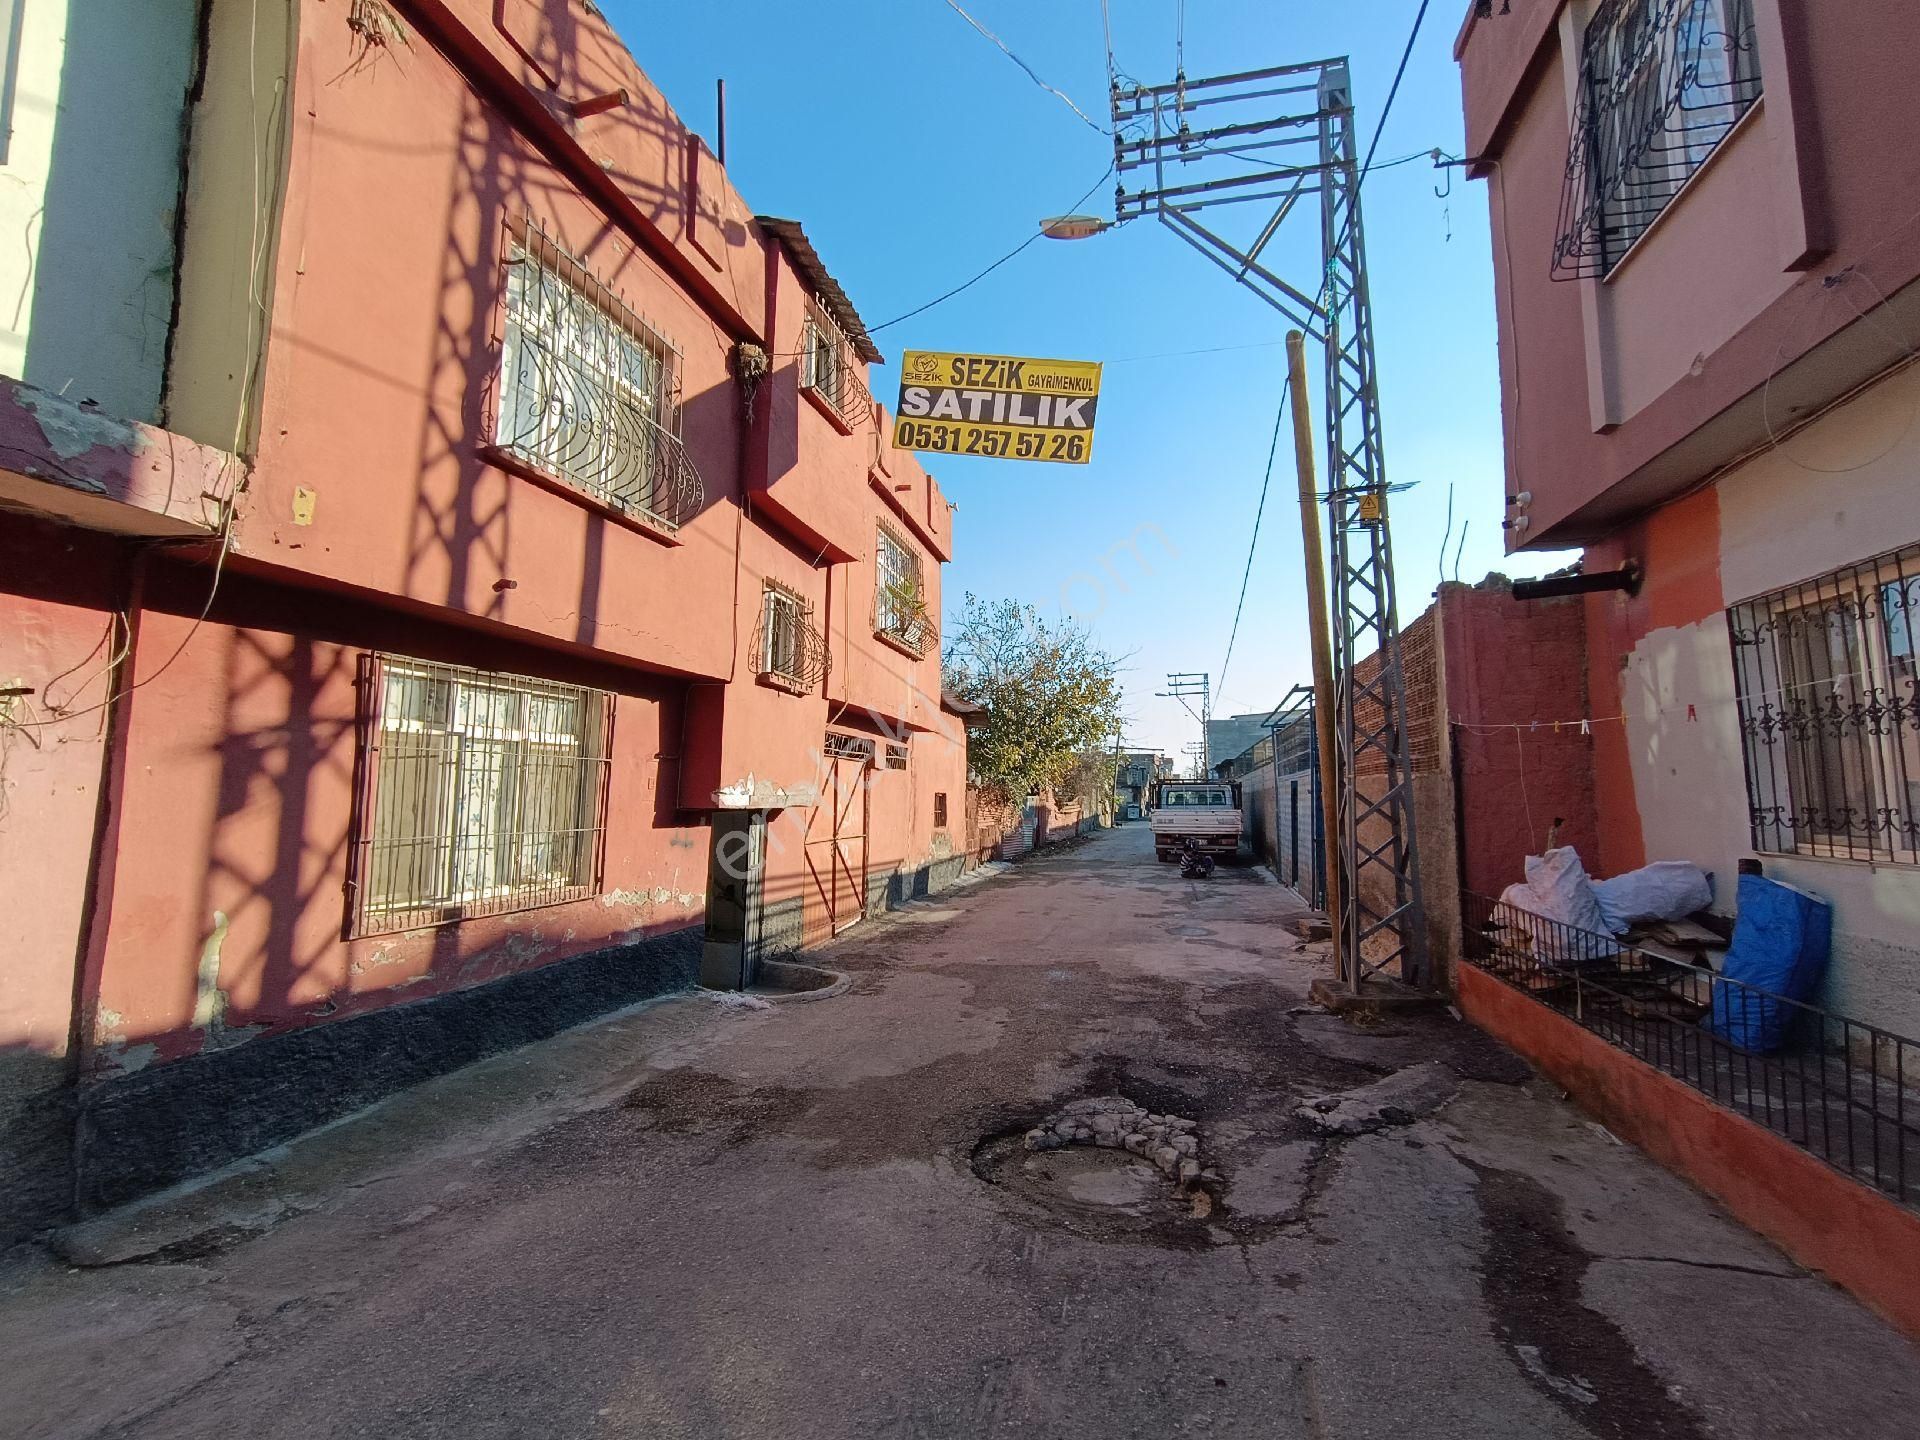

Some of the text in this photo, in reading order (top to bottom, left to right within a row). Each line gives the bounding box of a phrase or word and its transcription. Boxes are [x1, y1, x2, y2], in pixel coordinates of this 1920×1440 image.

[1027, 372, 1093, 392] GAYRİMENKUL
[901, 387, 1090, 428] SATILIK
[899, 421, 1085, 461] 0531 257 57 26
